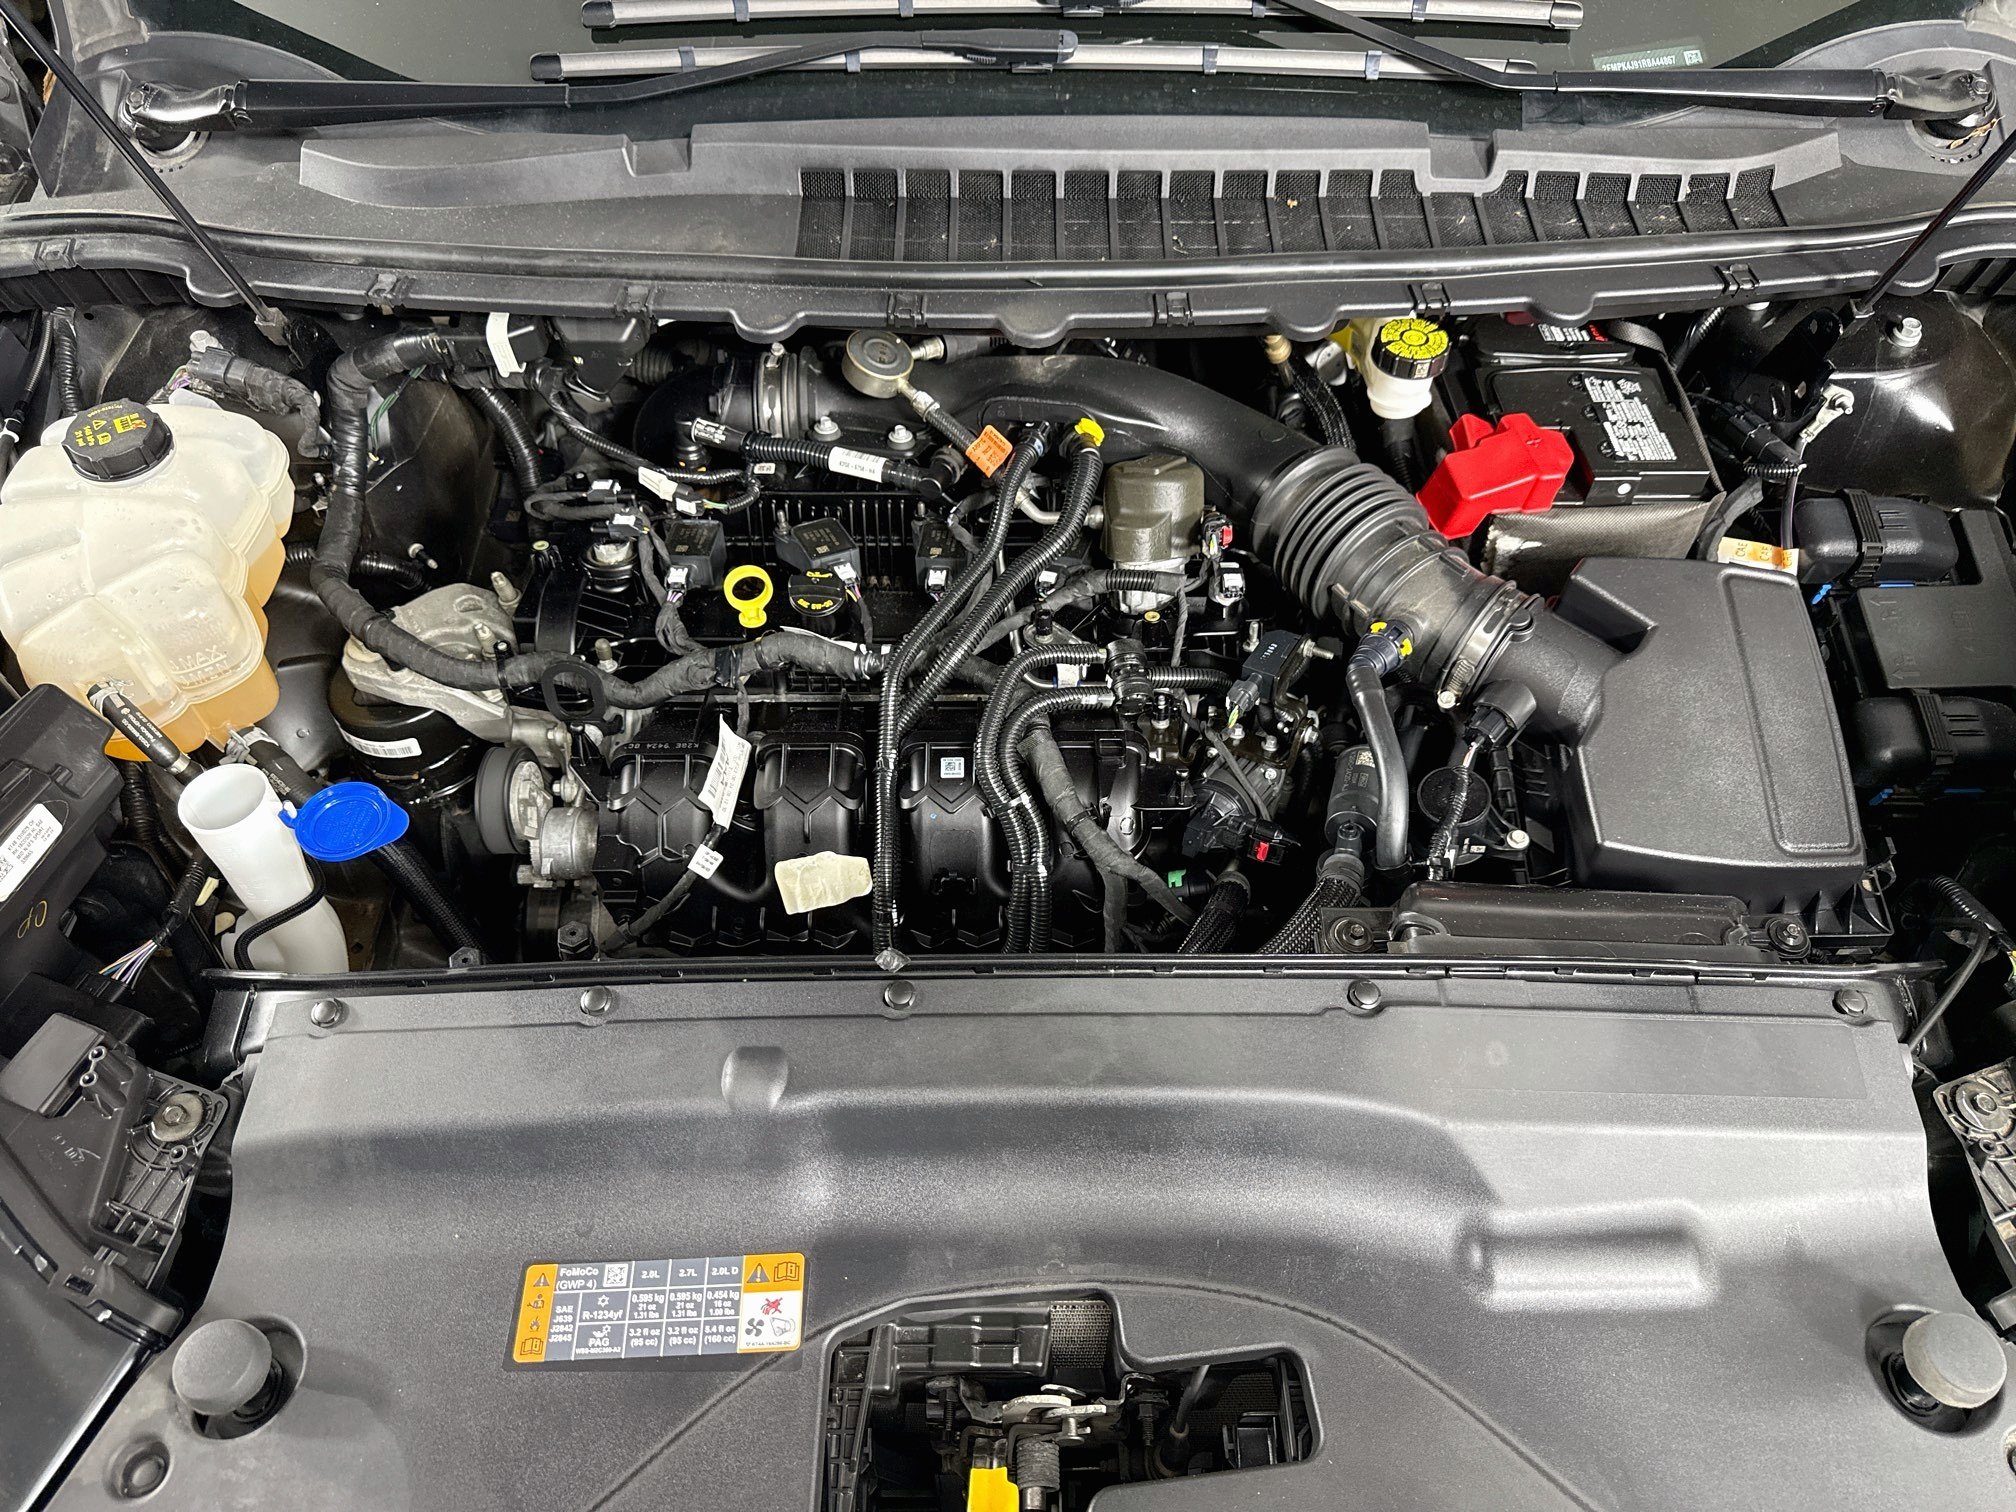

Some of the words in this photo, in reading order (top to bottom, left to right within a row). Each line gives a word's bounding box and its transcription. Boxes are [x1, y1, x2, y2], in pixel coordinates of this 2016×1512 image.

[560, 1266, 599, 1277] FoMoCo
[641, 1270, 660, 1279] 2.0L
[679, 1268, 698, 1277] 2.7L
[711, 1267, 730, 1276] 2.0L
[731, 1266, 739, 1275] D
[556, 1280, 585, 1291] (GWP
[586, 1279, 597, 1290] 4)
[632, 1293, 654, 1303] 0.595
[654, 1293, 665, 1304] kg
[669, 1292, 691, 1302] 0.595
[692, 1292, 703, 1302] kg
[707, 1290, 728, 1300] 0.454
[729, 1290, 740, 1301] kg
[555, 1305, 573, 1313] SAE
[582, 1309, 624, 1320] R-1234yf
[628, 1328, 641, 1337] 3.2
[667, 1327, 680, 1335] 3.2
[588, 1338, 610, 1347] PAG
[644, 1337, 658, 1347] cc)
[683, 1336, 697, 1346] cc)
[723, 1335, 736, 1343] cc)
